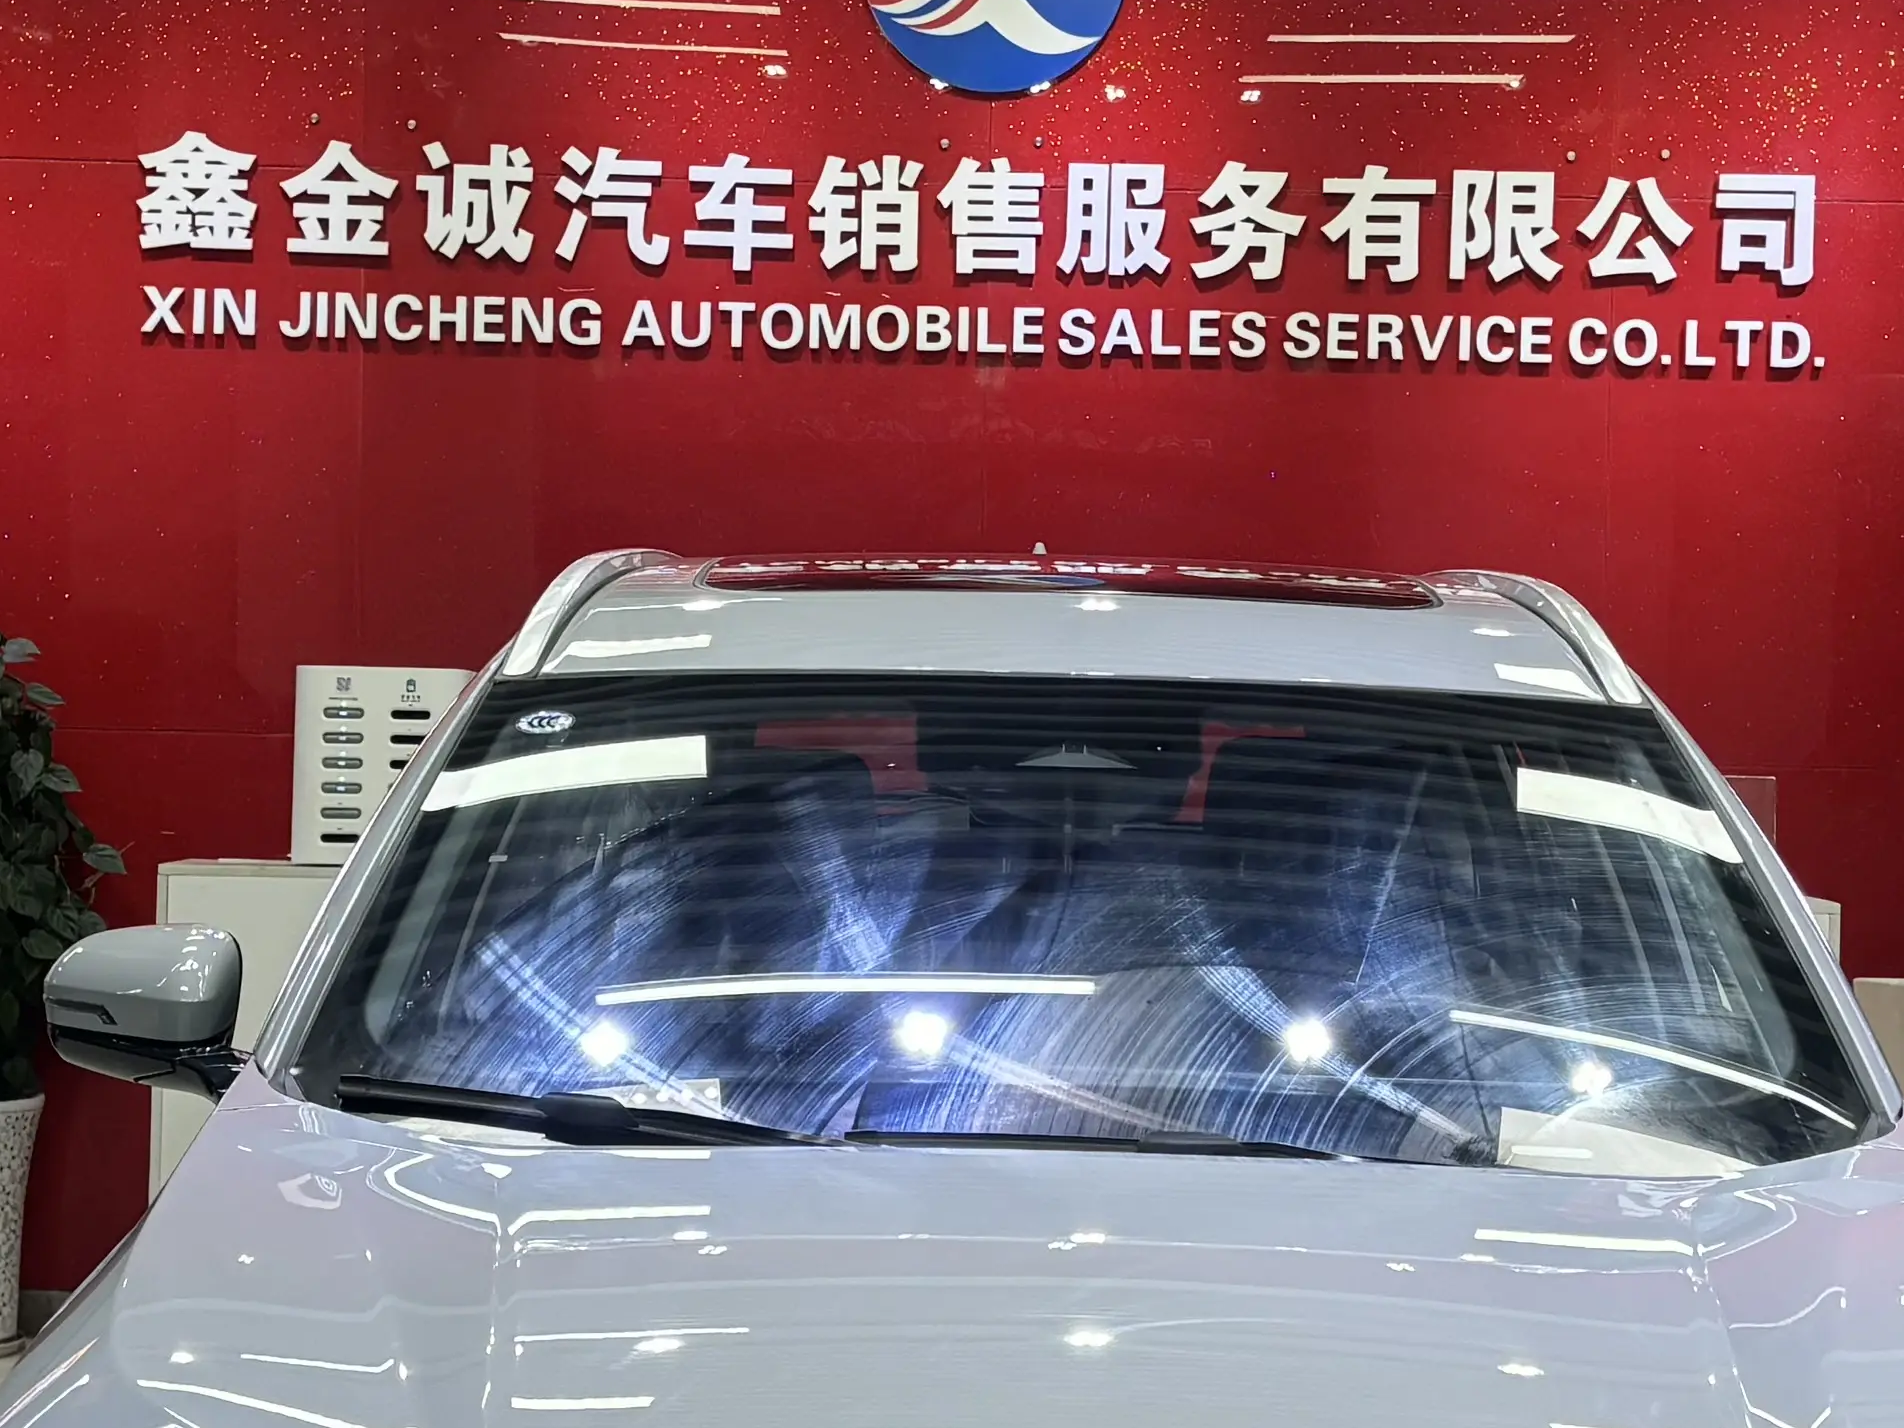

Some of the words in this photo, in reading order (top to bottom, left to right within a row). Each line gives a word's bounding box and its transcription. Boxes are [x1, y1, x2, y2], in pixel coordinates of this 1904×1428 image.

[136, 131, 1816, 287] 鑫金诚汽车销售服务有限公司
[141, 286, 256, 337] XIN
[279, 291, 602, 346] JINCHENG
[622, 299, 1045, 355] AUTOMOBILE
[1059, 309, 1266, 359] SALES
[1284, 312, 1552, 364] SERVICE
